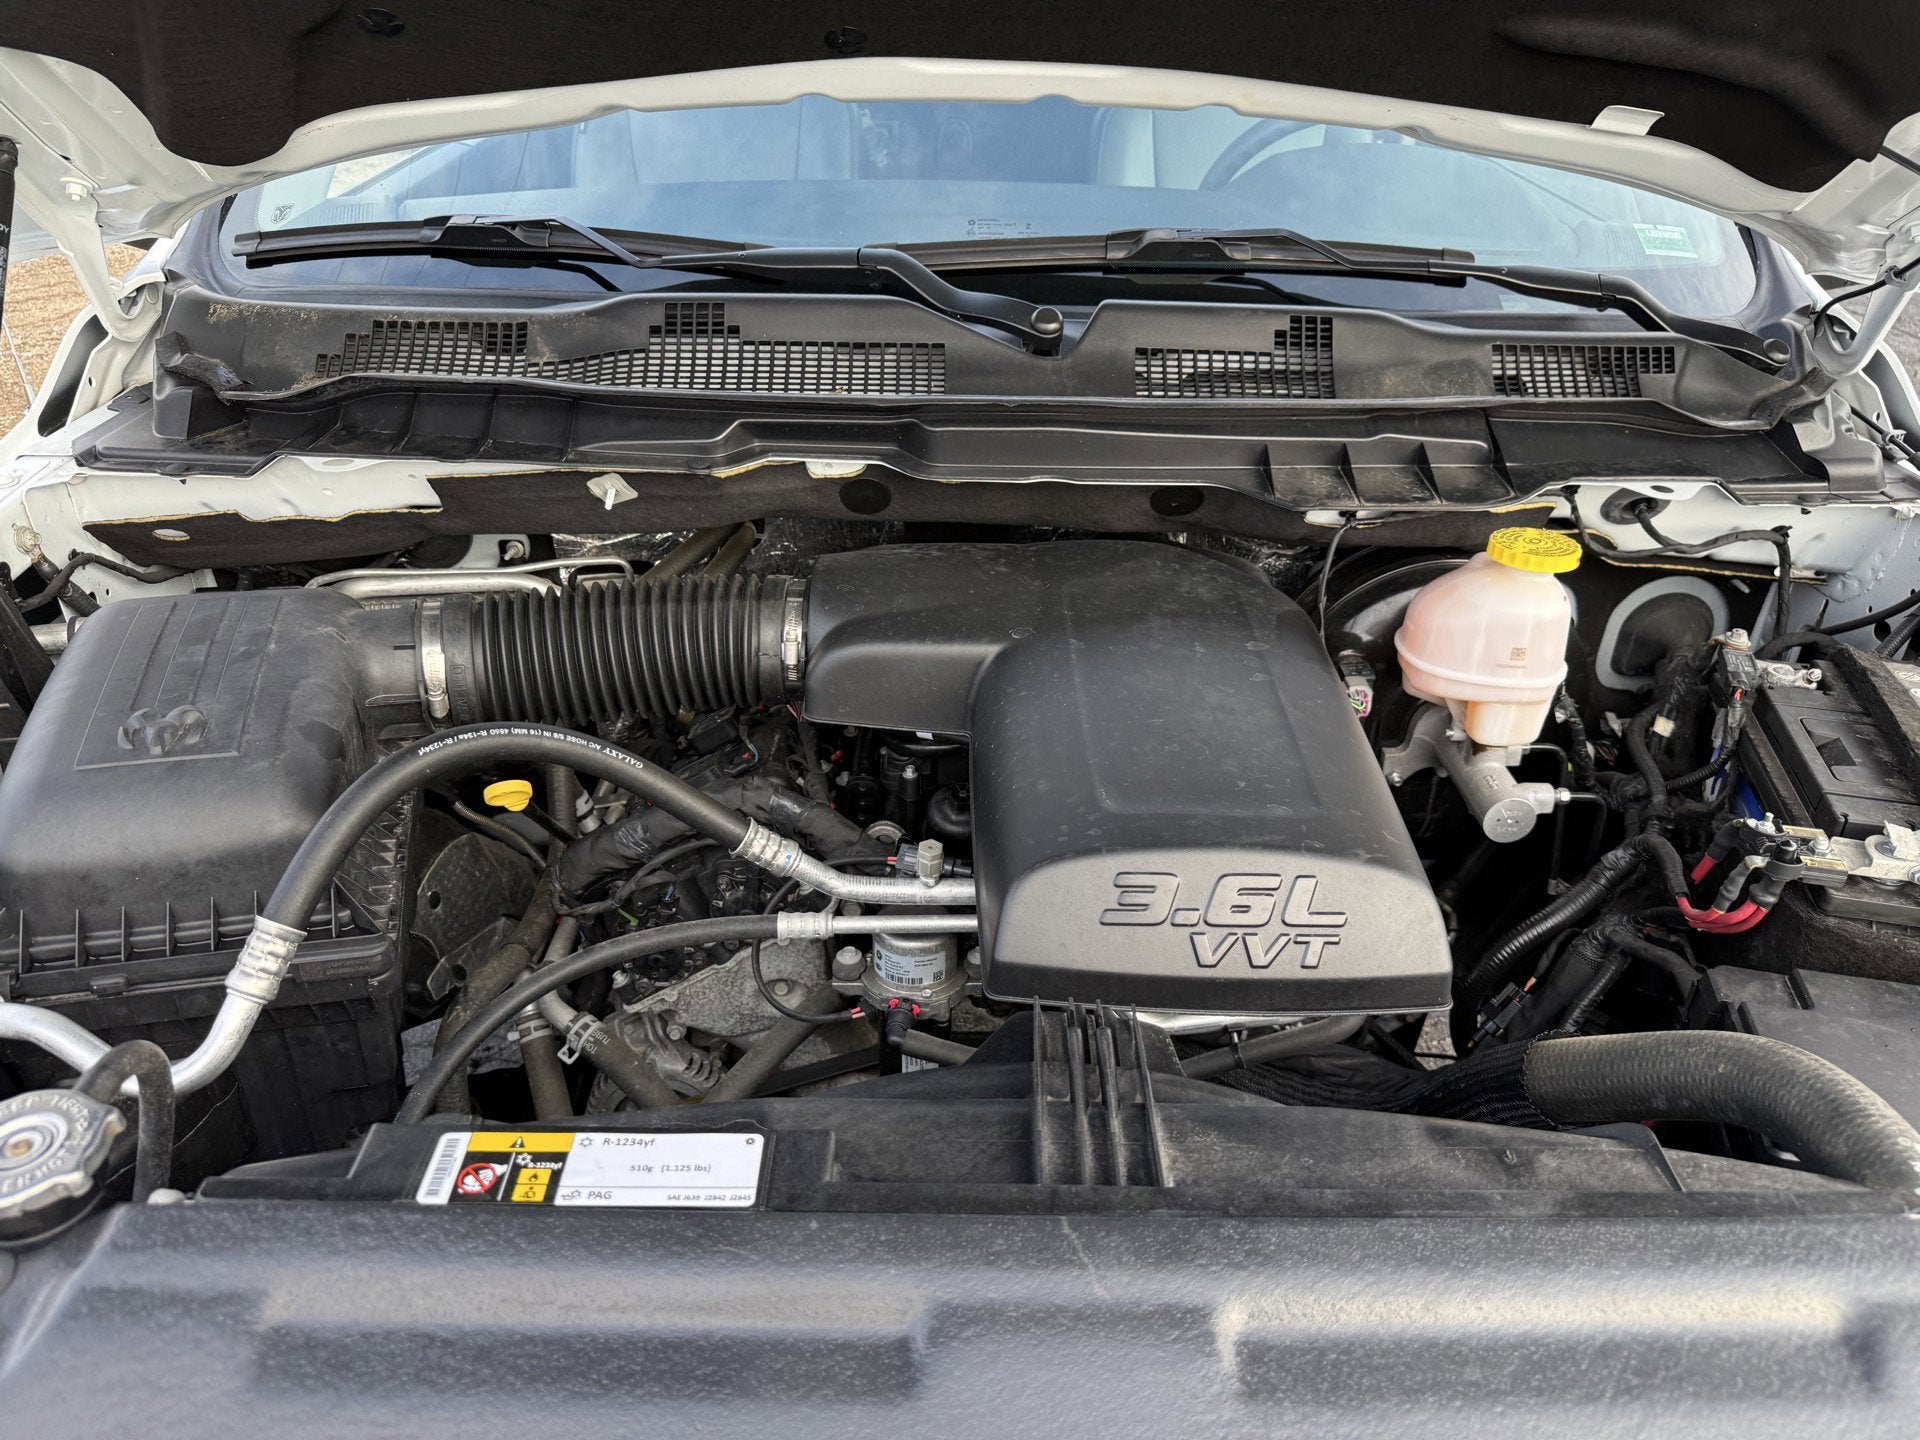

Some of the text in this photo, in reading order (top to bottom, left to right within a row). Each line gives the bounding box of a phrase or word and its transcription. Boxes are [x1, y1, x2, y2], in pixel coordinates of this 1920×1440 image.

[458, 729, 487, 740] R-134a
[511, 726, 528, 736] MM)
[543, 730, 552, 738] IN
[553, 732, 564, 740] 5/8
[566, 735, 587, 746] HOSE
[588, 742, 601, 750] A/C
[418, 738, 453, 756] R-1234yf
[603, 747, 643, 768] GALAXY
[1100, 871, 1348, 928] 3.6L
[1188, 931, 1342, 970] VVT
[602, 1137, 656, 1148] R-1234yf
[629, 1164, 712, 1174] 510g (1.125 lbs)
[587, 1190, 613, 1200] PAG
